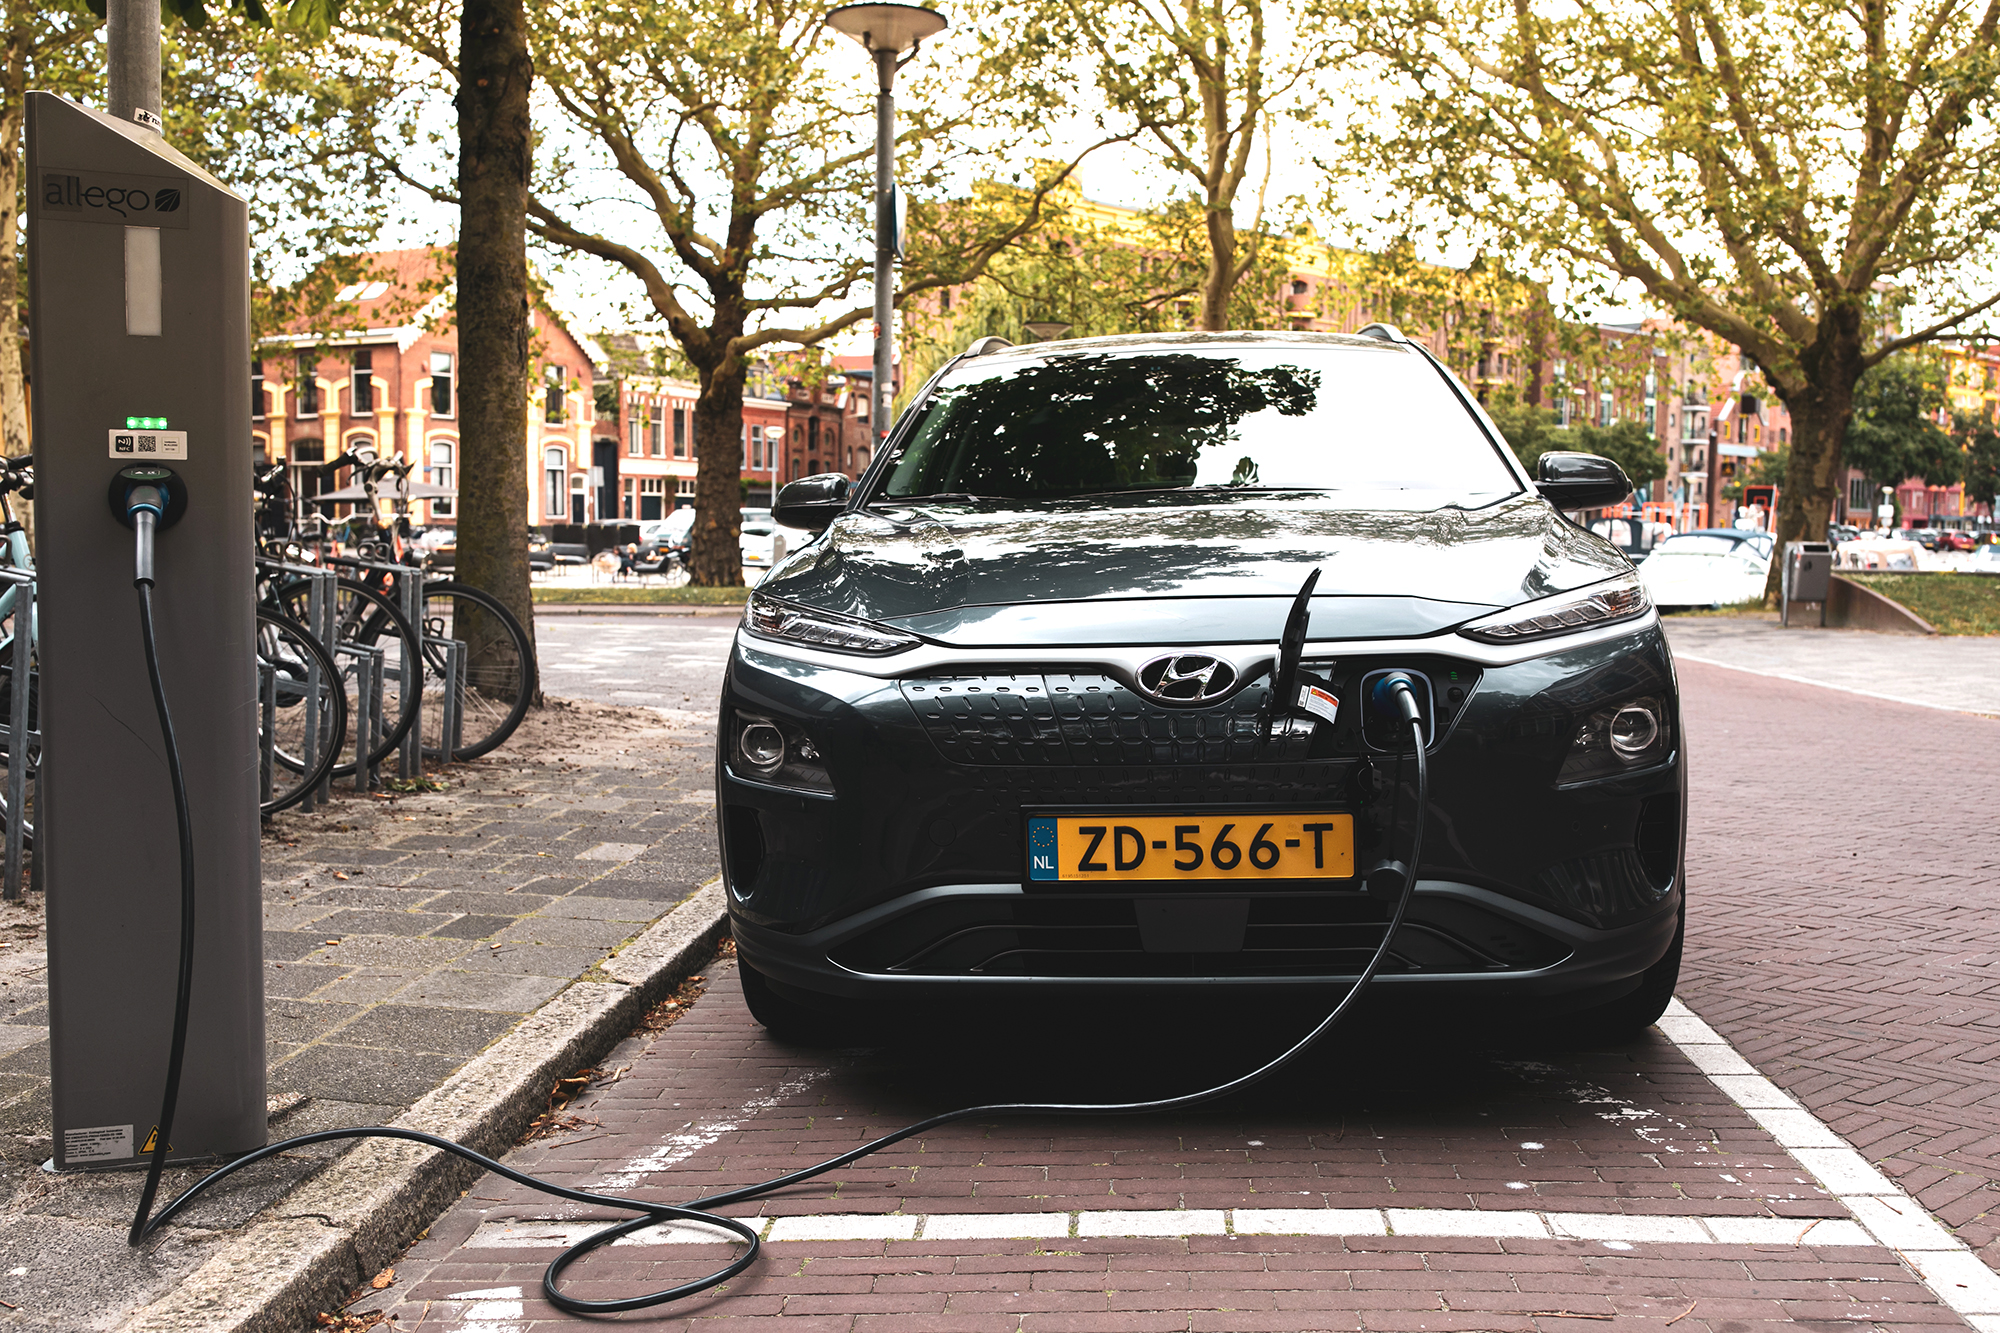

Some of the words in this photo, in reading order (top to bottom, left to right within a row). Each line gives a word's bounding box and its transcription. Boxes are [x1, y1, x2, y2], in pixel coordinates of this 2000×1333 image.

[46, 176, 150, 218] allego
[1033, 855, 1055, 870] NL
[1078, 823, 1333, 872] ZD-566-T
